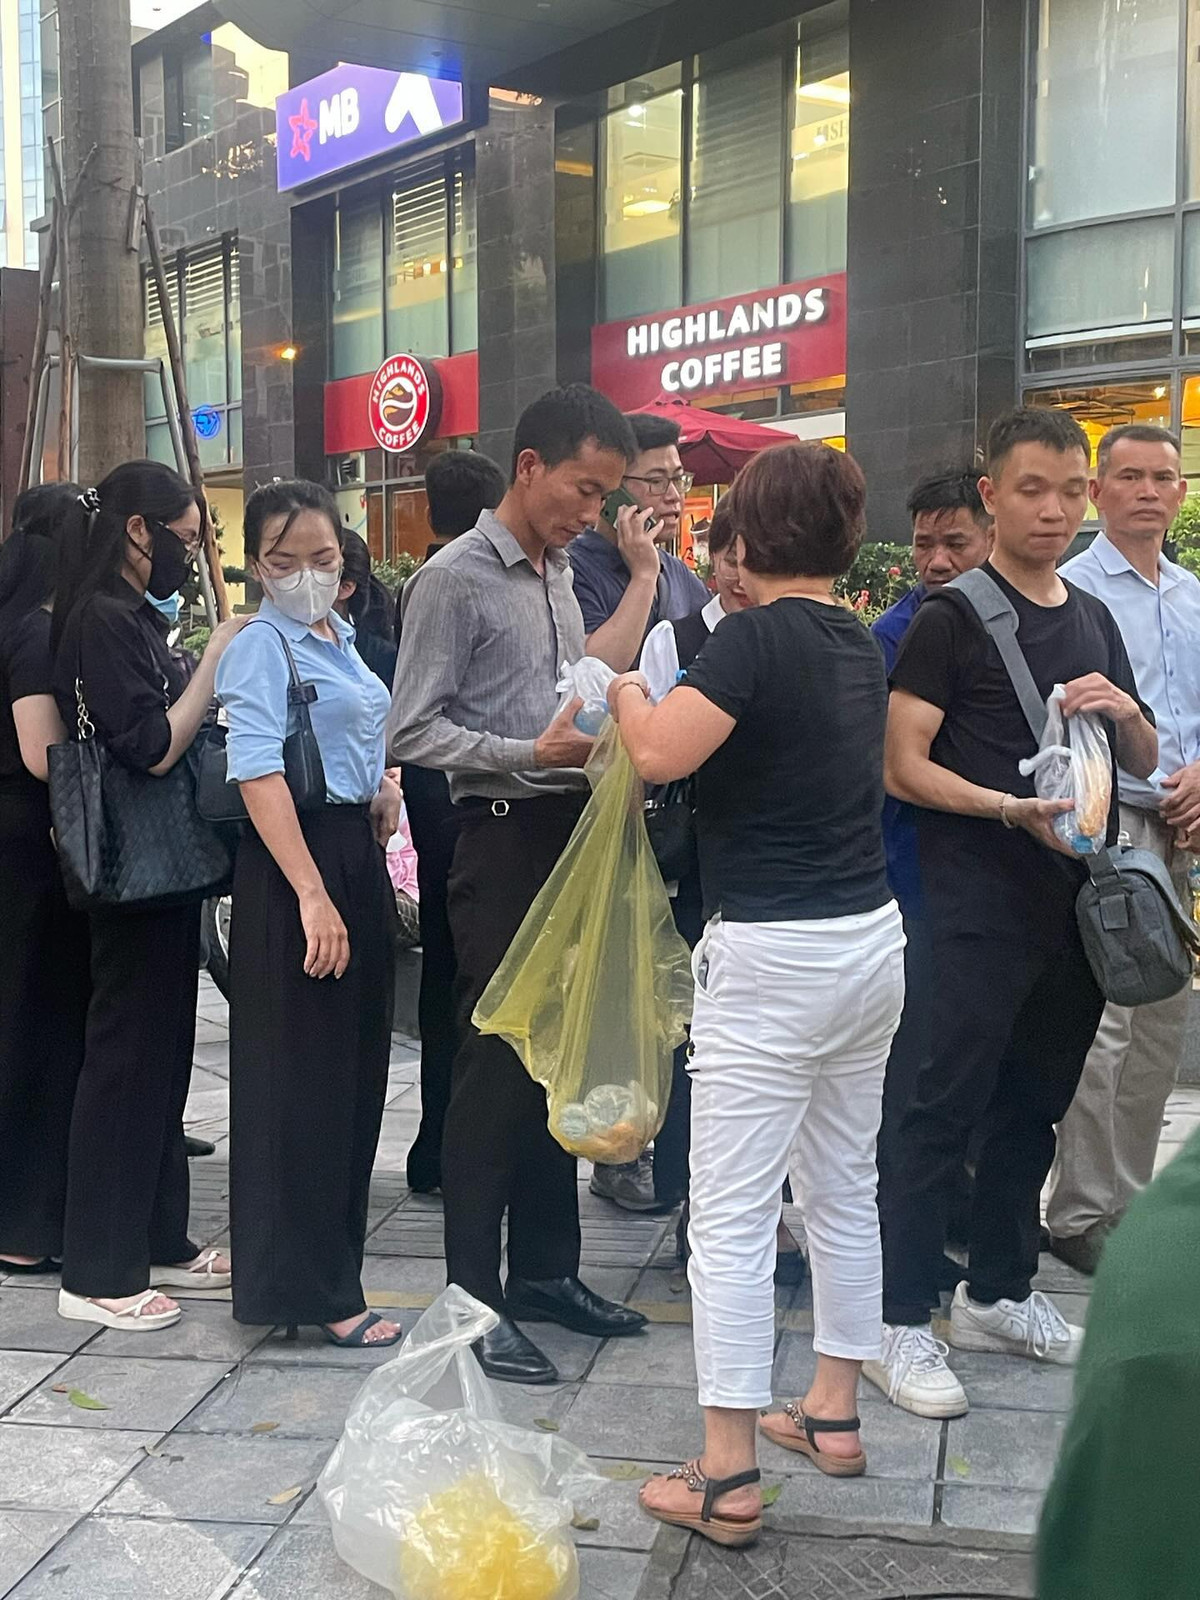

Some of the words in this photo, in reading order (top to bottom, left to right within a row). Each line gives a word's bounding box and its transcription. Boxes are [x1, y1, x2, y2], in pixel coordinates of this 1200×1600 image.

[319, 87, 360, 145] MB
[627, 288, 825, 357] HIGHLANDS
[372, 360, 426, 404] HIGHLANDS
[661, 342, 782, 392] COFFEE
[378, 420, 420, 447] COFFEE
